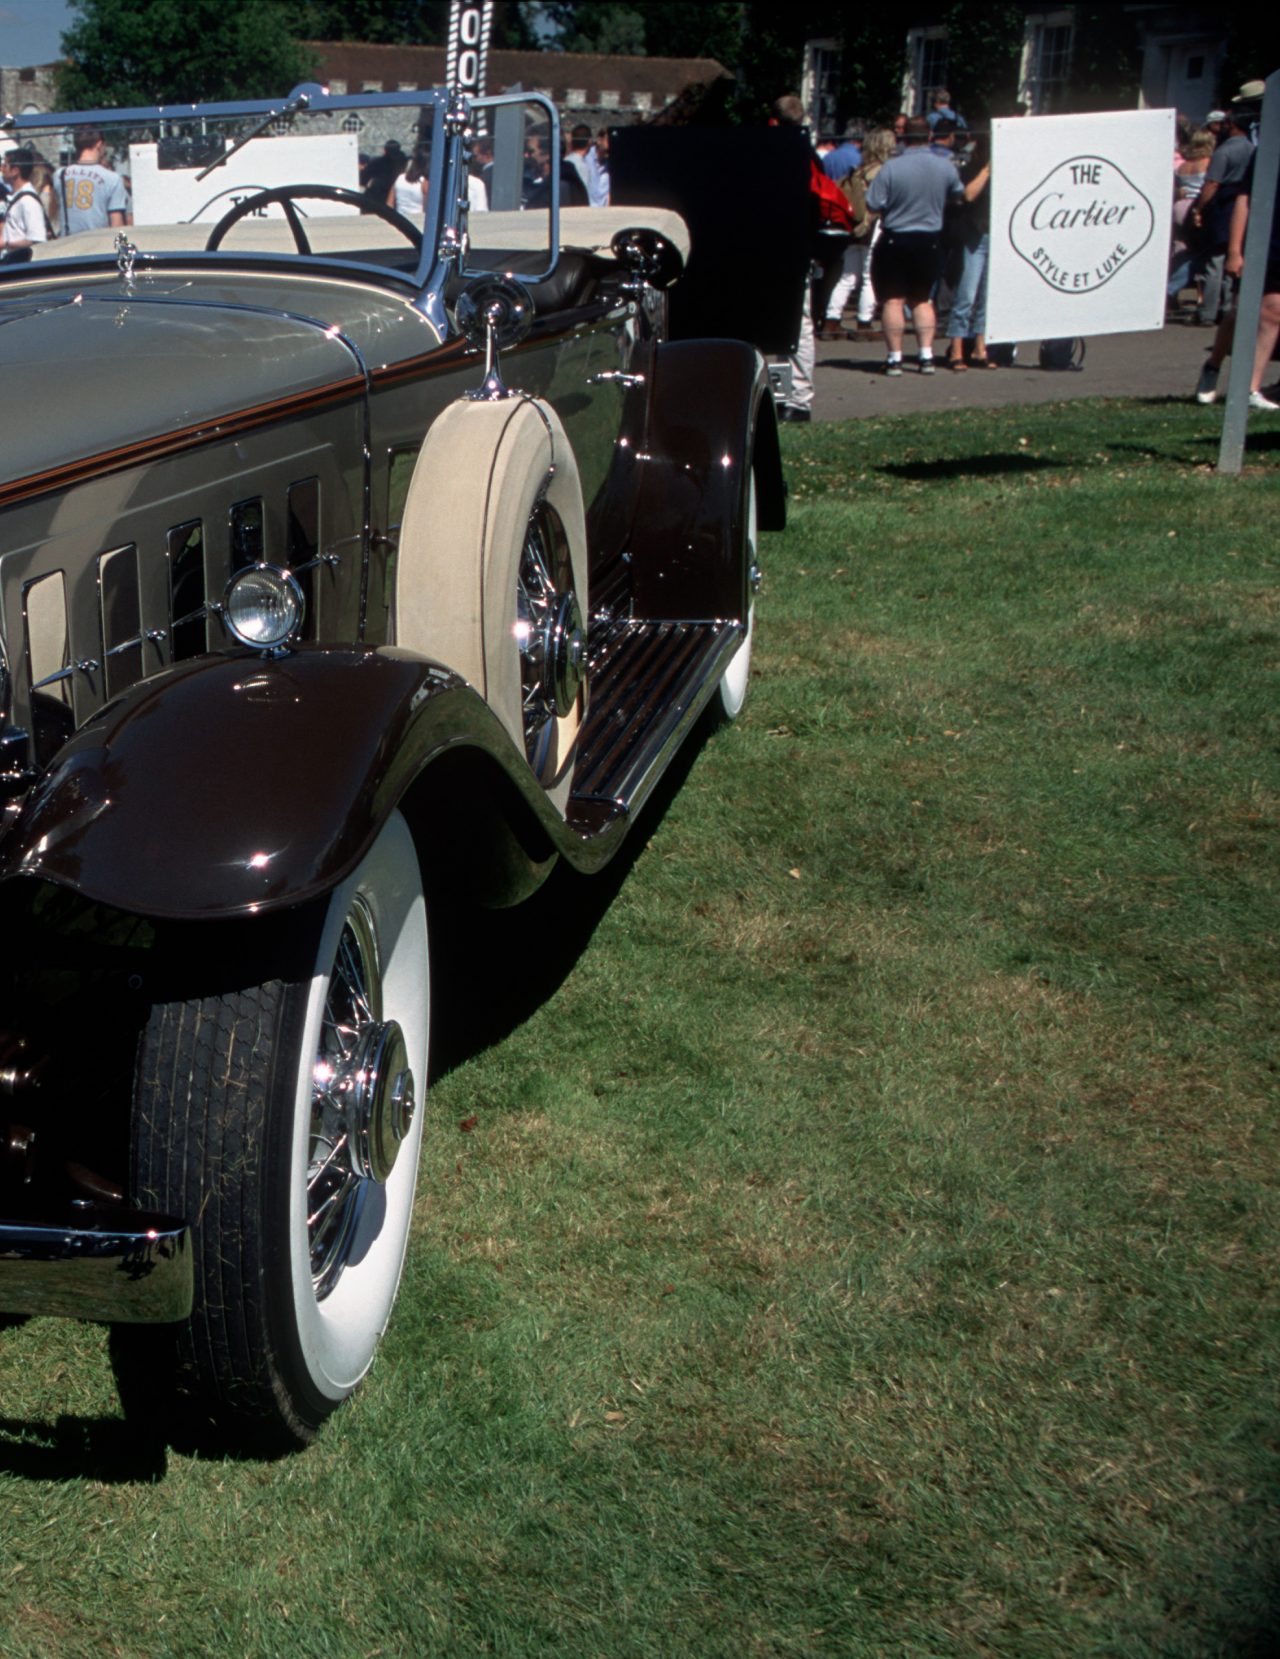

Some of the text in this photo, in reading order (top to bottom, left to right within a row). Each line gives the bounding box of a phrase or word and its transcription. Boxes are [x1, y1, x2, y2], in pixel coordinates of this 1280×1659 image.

[1070, 164, 1102, 185] THE
[65, 178, 94, 210] 18
[1030, 192, 1135, 231] Cartier
[1032, 243, 1128, 288] STYLE ET LUXE
